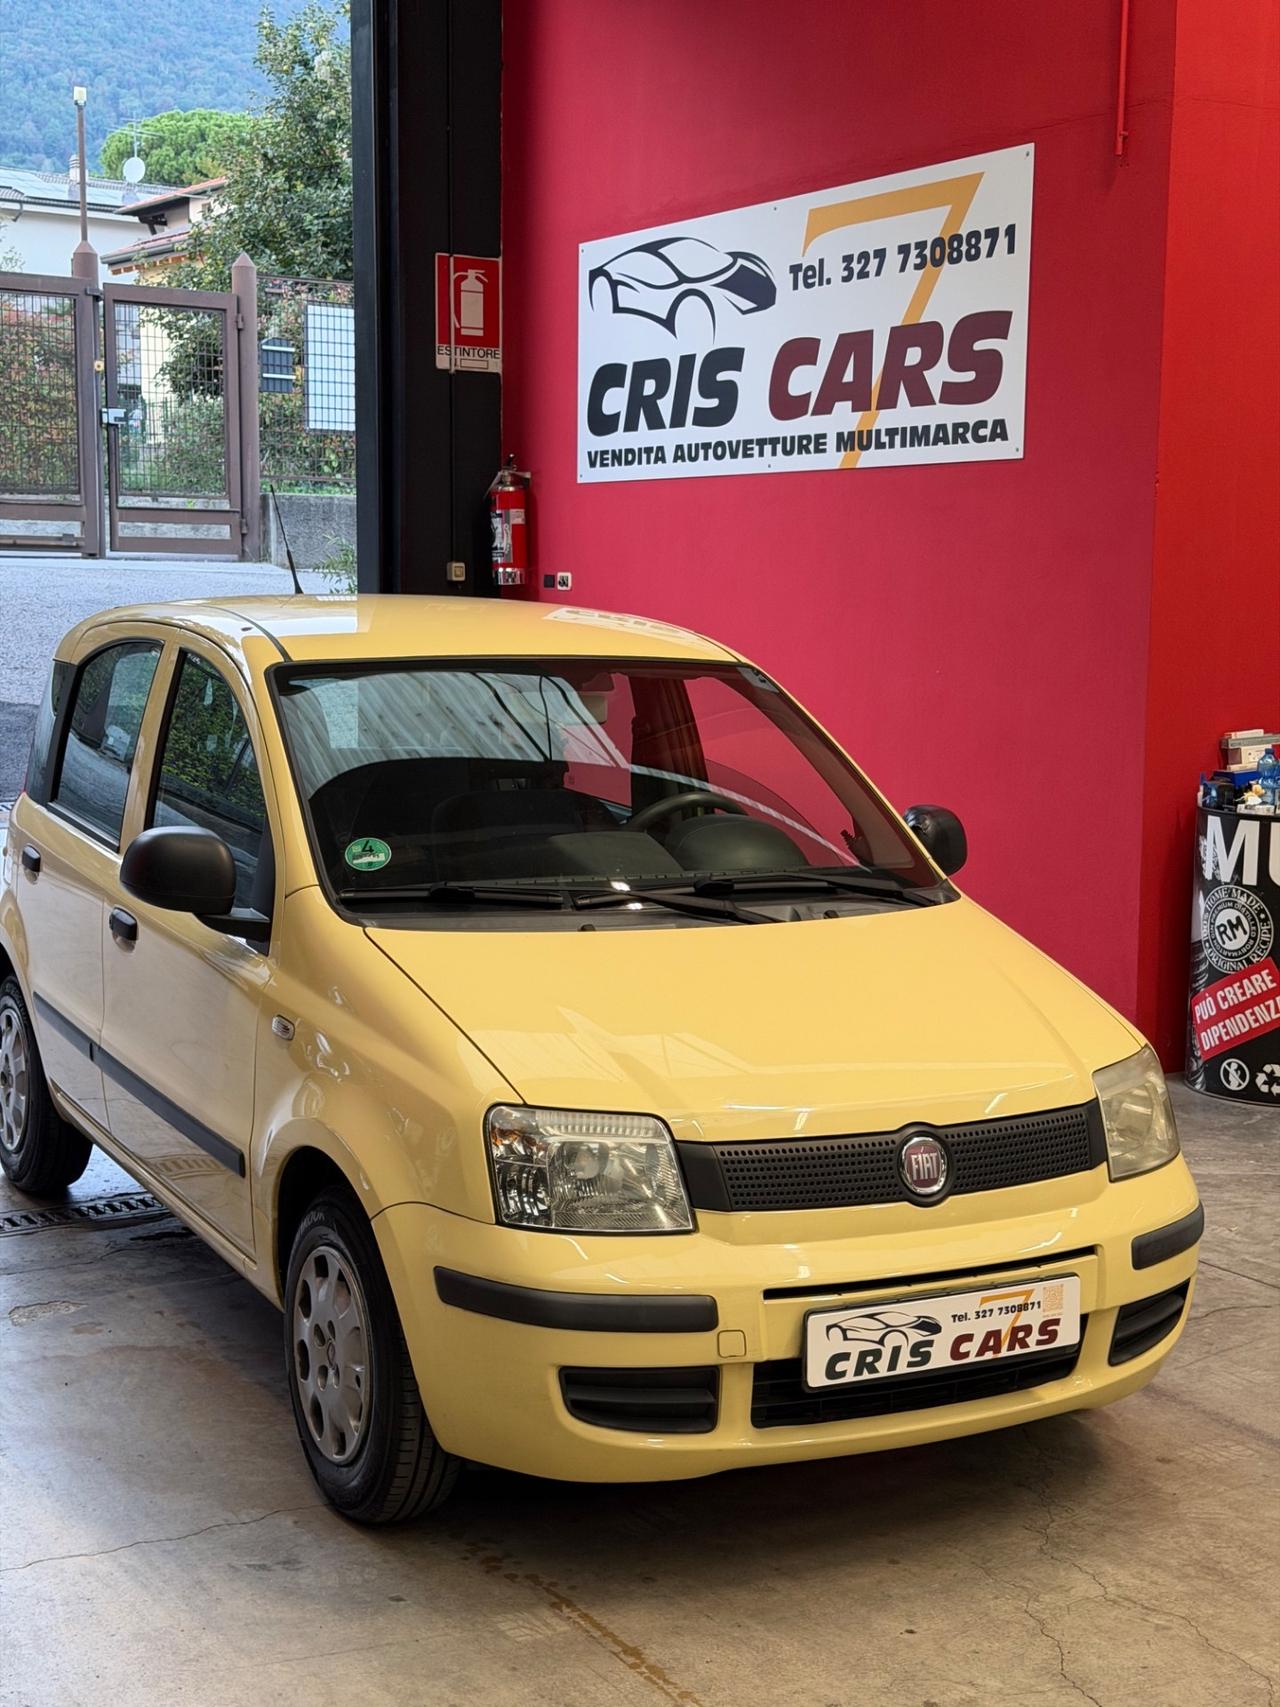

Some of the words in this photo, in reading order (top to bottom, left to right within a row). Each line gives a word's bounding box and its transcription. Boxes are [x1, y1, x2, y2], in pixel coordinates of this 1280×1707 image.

[789, 257, 831, 291] Tel.
[841, 247, 886, 283] 327
[897, 223, 1016, 273] 7308871
[437, 345, 501, 360] ESTINTORE
[586, 346, 745, 437] CRIS
[768, 310, 1013, 421] CARS
[587, 444, 666, 469] VENDITA
[672, 432, 827, 462] AUTOVETTURE
[835, 418, 1009, 455] MULTIMARCA
[1204, 815, 1280, 888] M
[1206, 887, 1229, 911] HOME
[1231, 888, 1263, 914] MADE
[1216, 915, 1248, 945] RM
[1249, 921, 1271, 964] RECIPE
[1194, 992, 1217, 1024] PUÒ
[1216, 969, 1277, 1010] CREARE
[1200, 996, 1280, 1051] DIPENDENZ
[911, 1152, 938, 1181] FIAT
[951, 1312, 971, 1323] Tel.
[974, 1308, 994, 1320] 327
[997, 1301, 1041, 1316] 7308871
[824, 1339, 935, 1381] CRIS
[950, 1318, 1061, 1361] CARS
